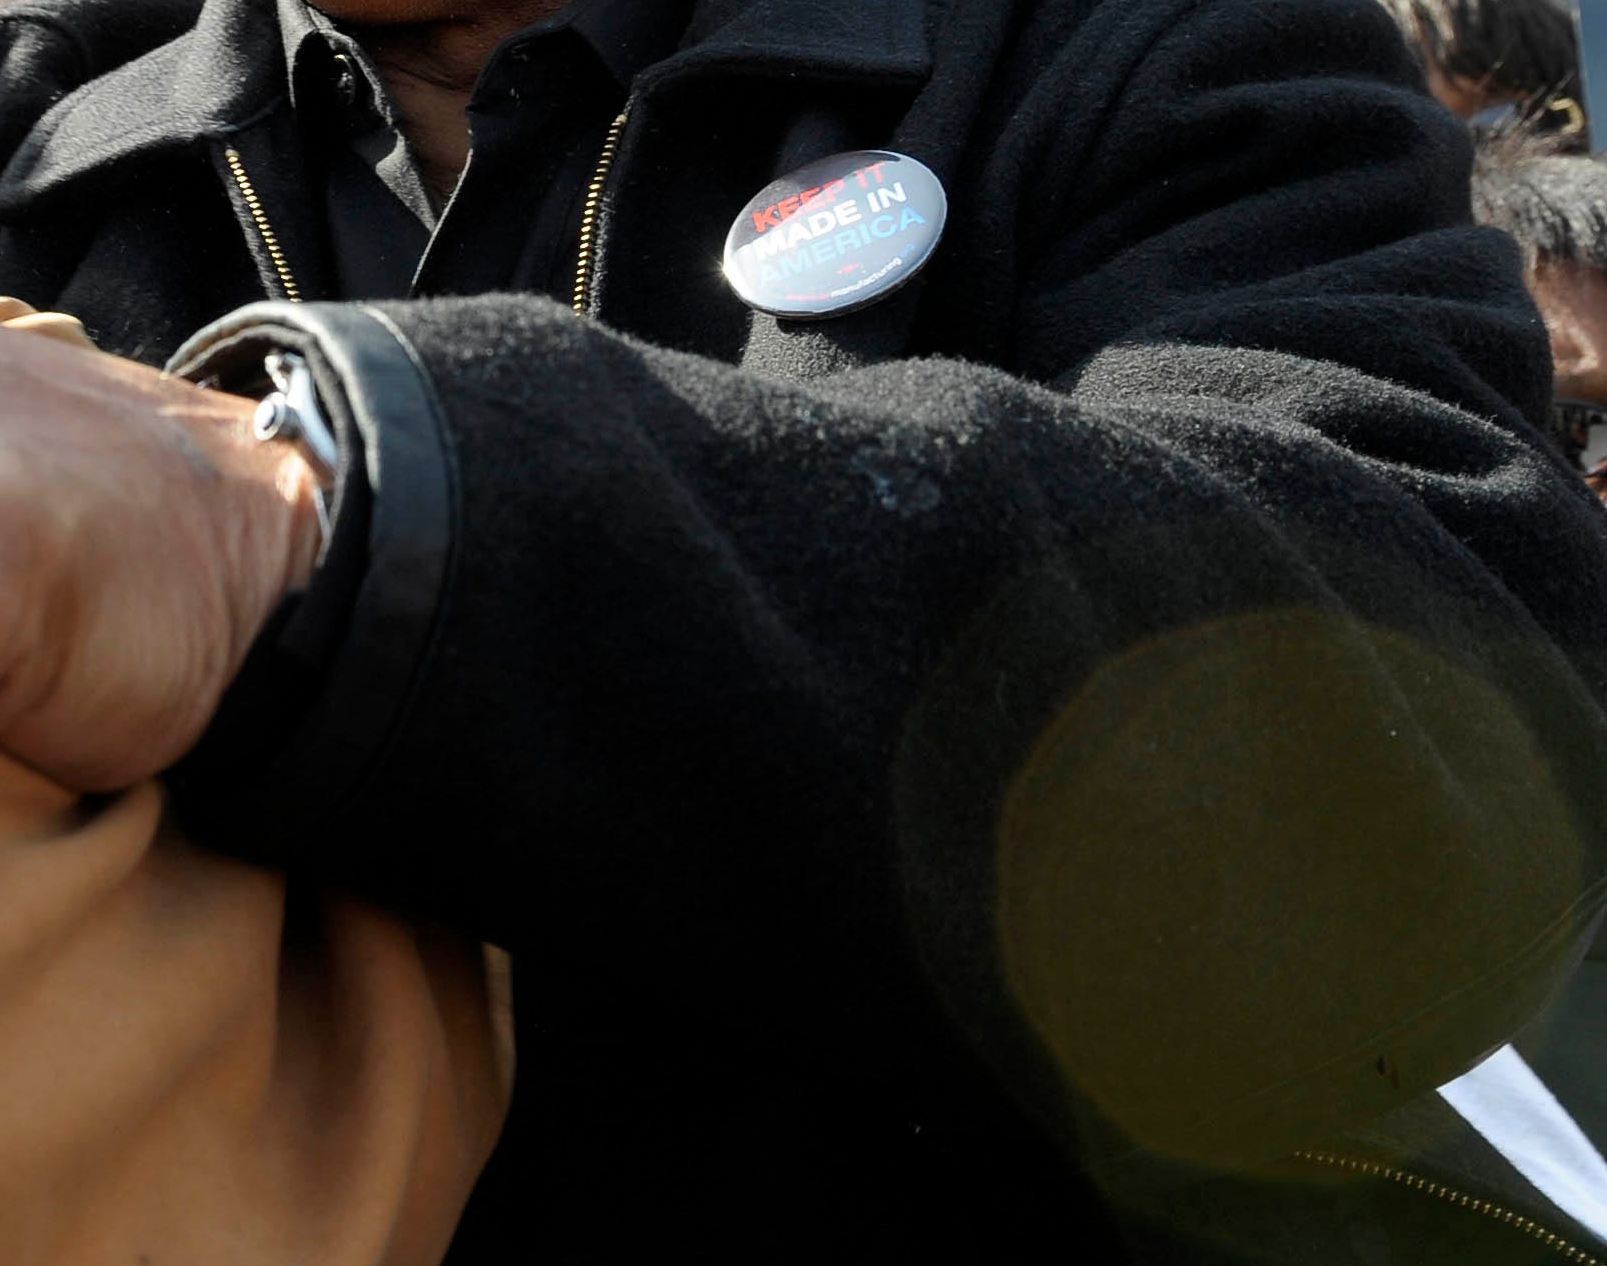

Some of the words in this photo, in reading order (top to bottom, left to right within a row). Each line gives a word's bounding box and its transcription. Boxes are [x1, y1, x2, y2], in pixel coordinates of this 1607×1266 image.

[752, 178, 847, 233] KEEP
[855, 160, 887, 190] IT
[754, 199, 863, 261] MADE
[866, 181, 908, 213] IN
[761, 205, 927, 285] AMERICA
